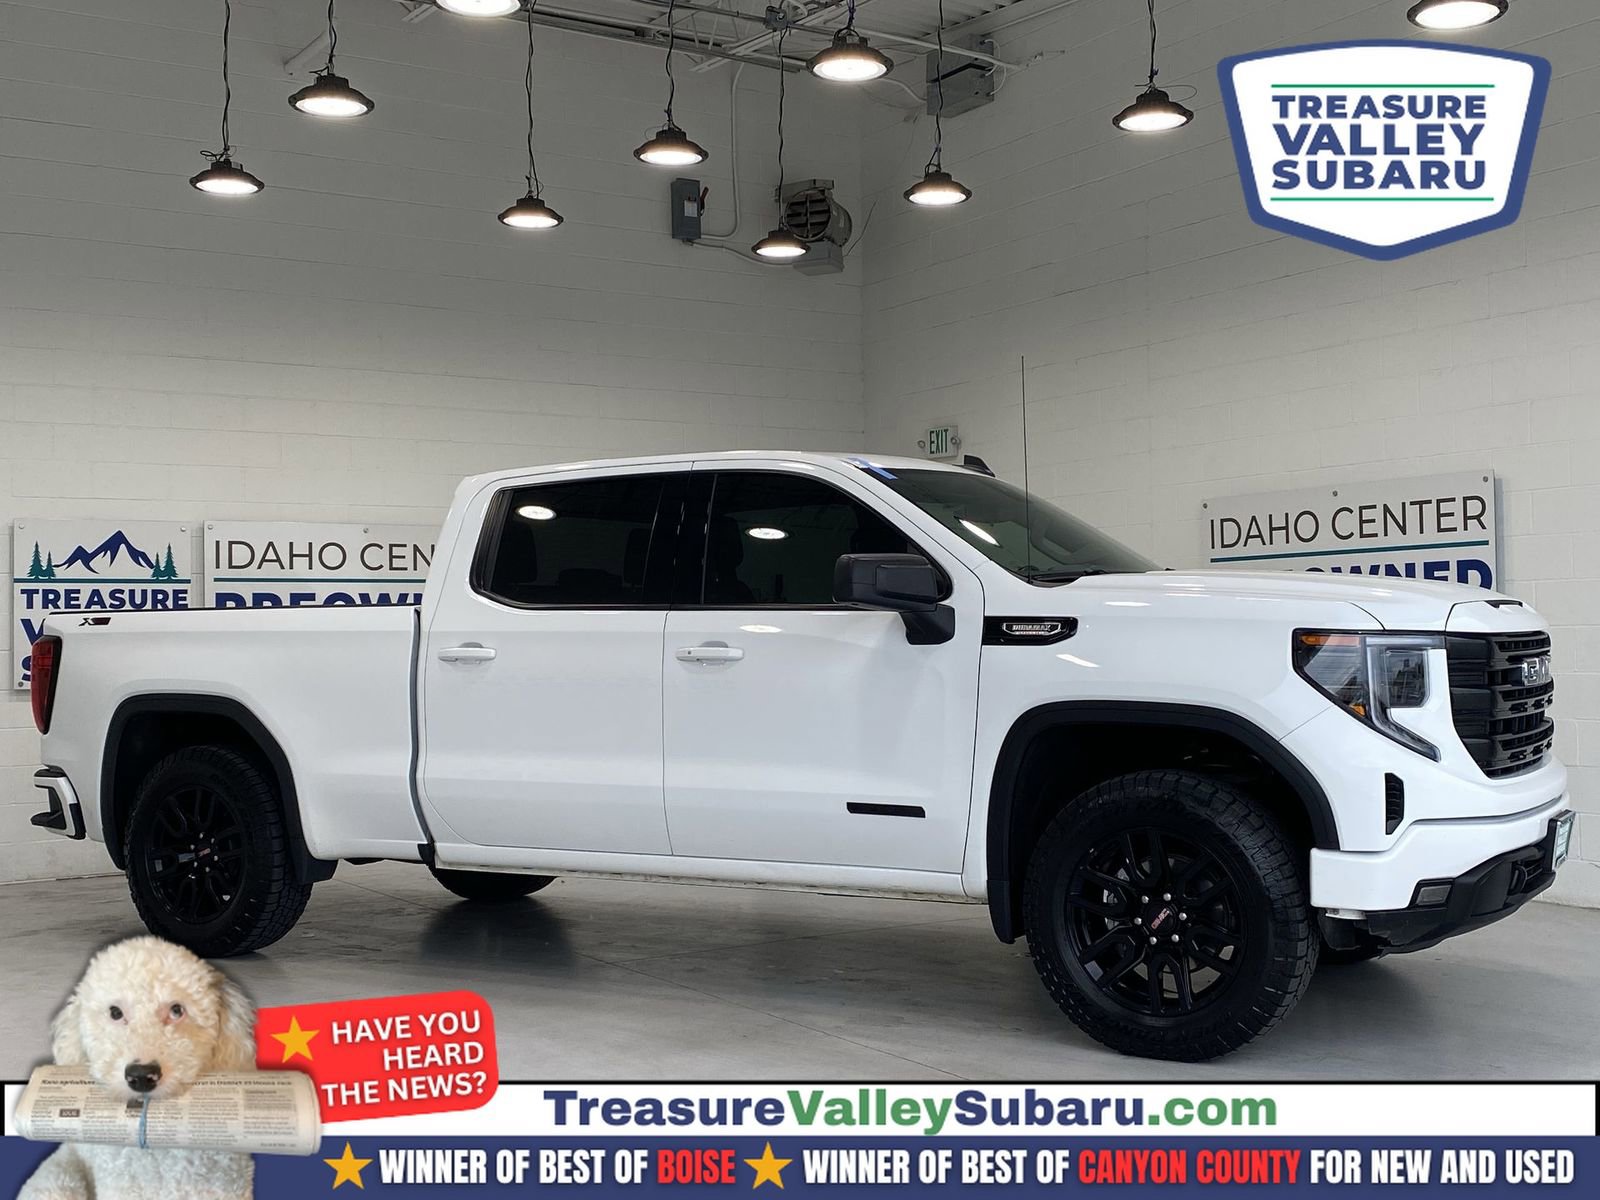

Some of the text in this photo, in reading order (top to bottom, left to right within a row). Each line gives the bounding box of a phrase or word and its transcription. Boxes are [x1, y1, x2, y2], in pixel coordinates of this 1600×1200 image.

[929, 428, 949, 455] EXIT
[1210, 495, 1488, 550] IDAHO CENTER
[214, 540, 347, 571] IDAHO
[20, 588, 189, 610] TREASURE
